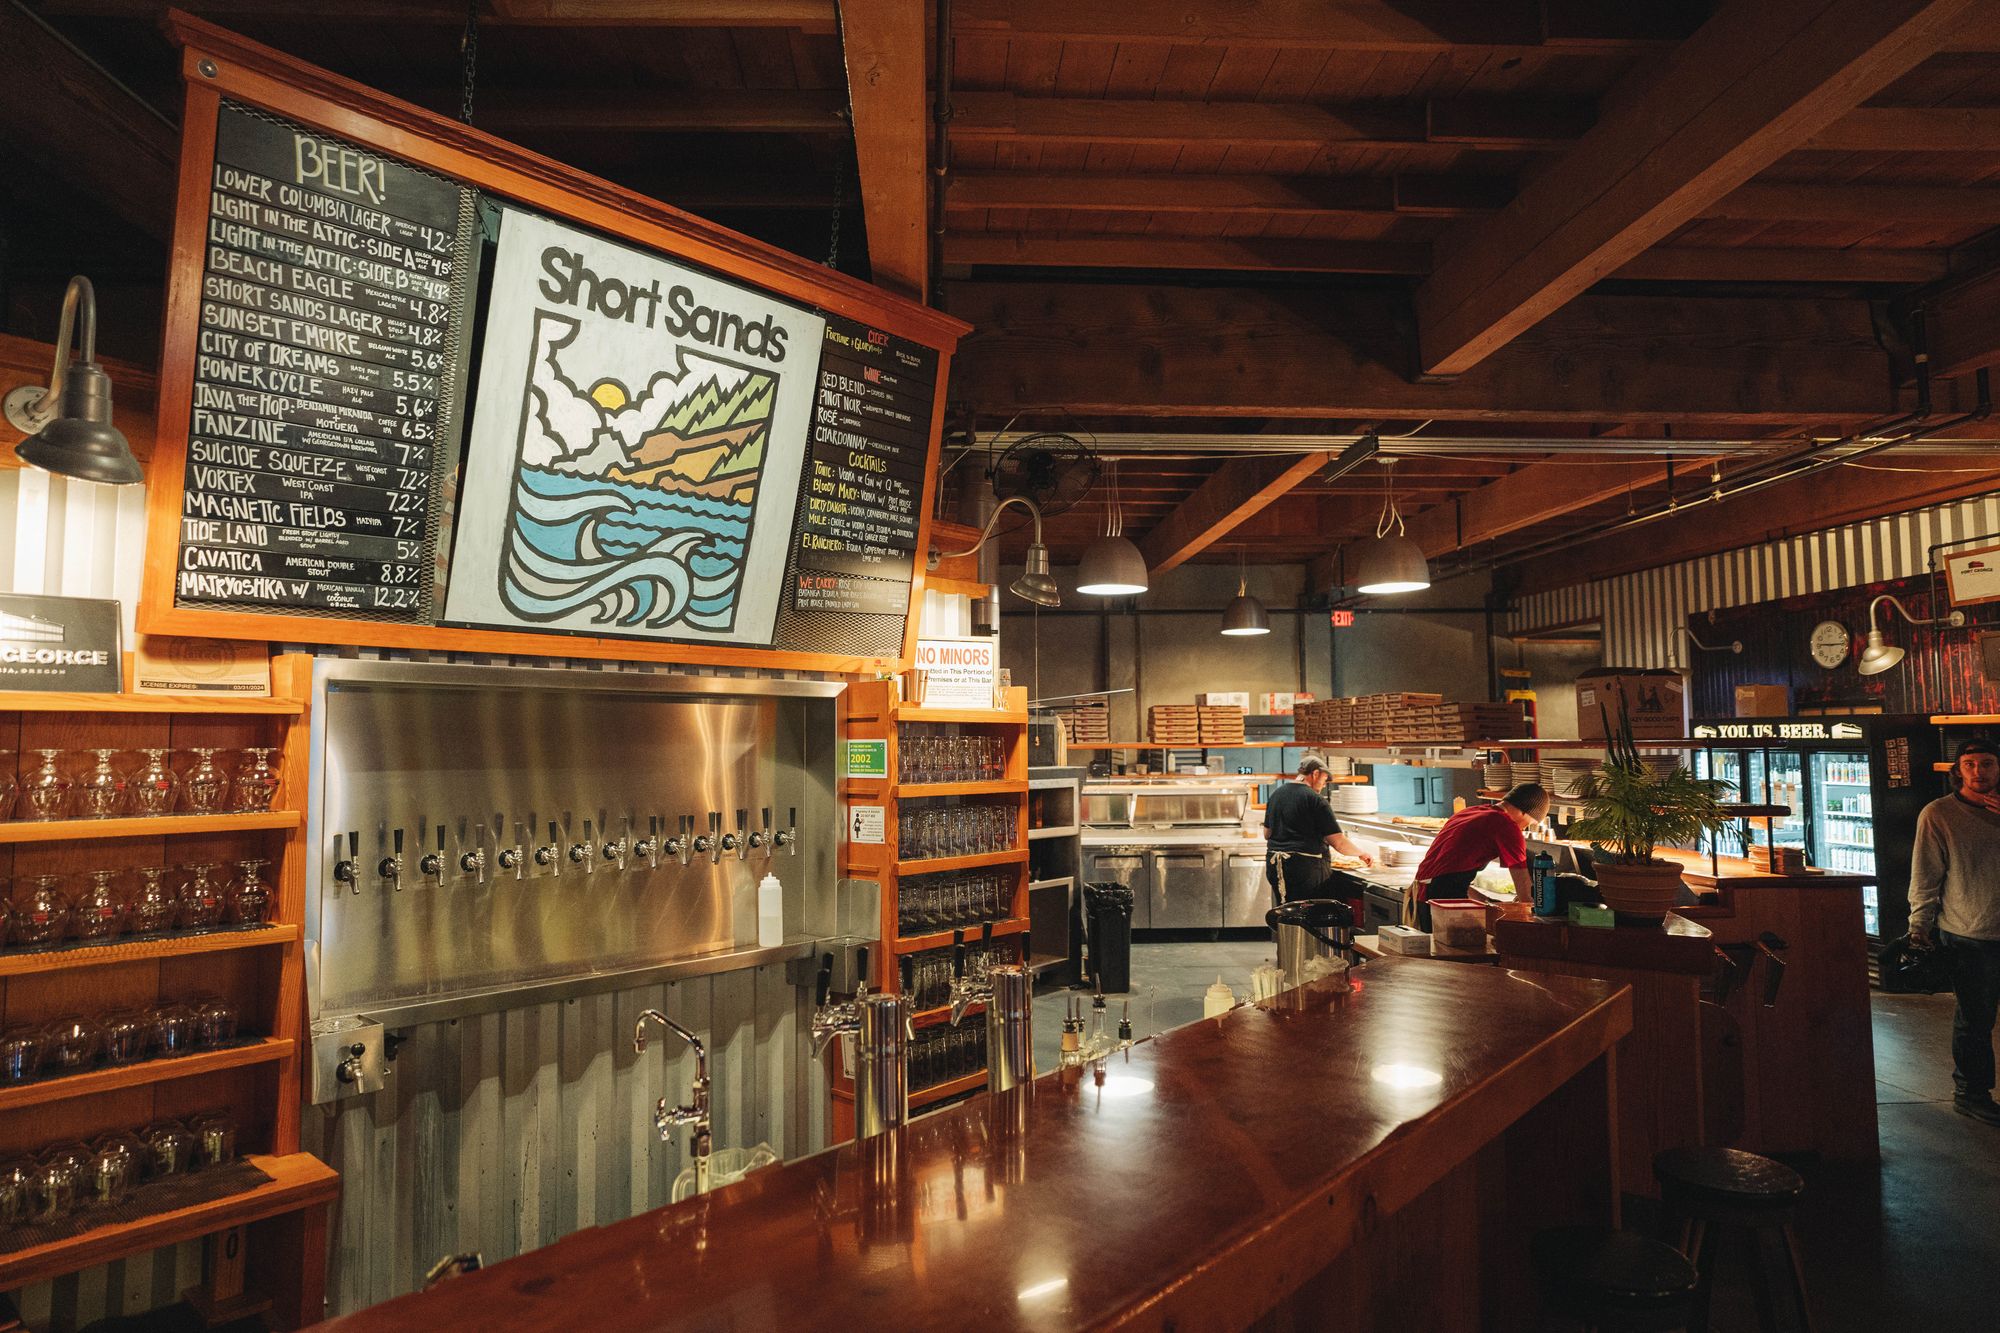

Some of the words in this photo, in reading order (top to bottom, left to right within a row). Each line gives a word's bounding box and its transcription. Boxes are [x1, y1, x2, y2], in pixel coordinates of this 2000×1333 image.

[294, 134, 385, 205] BEER!
[216, 164, 272, 202] LOWER
[280, 185, 348, 222] COLUMBIA
[350, 205, 391, 236] LAGER
[212, 192, 260, 225] LIGHT
[264, 209, 279, 226] IN
[281, 213, 308, 234] THE
[404, 248, 417, 271] A
[420, 226, 455, 252] 4.2%
[211, 218, 260, 250] LIGHT
[263, 236, 276, 250] IN
[278, 240, 303, 256] THE
[396, 268, 409, 290] B
[211, 246, 283, 285] BEACH
[292, 268, 354, 300] EAGLE
[431, 259, 453, 276] 4.5%
[365, 288, 390, 300] MEXICAN
[391, 294, 407, 304] STYLE
[423, 281, 450, 299] 4.9%
[206, 277, 266, 306] SHORT
[270, 292, 327, 321] SANDS
[330, 305, 384, 336] LAGER
[377, 300, 397, 310] LAGER
[410, 300, 449, 324] 4.8%
[539, 246, 662, 329] Short
[664, 285, 788, 363] Sands
[205, 303, 286, 340] SUNSET
[291, 321, 362, 355] EMPIRE
[408, 325, 443, 346] 4.8%
[825, 326, 850, 346] FORTUNE
[201, 330, 238, 359] CITY
[244, 341, 266, 361] OF
[269, 342, 339, 376] DREAMS
[411, 350, 443, 369] 5.6%
[199, 354, 268, 390] POWER
[269, 370, 324, 396] CYCLE
[350, 364, 366, 373] HAZY
[342, 385, 358, 395] HAZY
[360, 389, 375, 398] PALE
[393, 371, 433, 392] 5.5%
[821, 370, 838, 388] RED
[840, 375, 866, 396] BLEND
[193, 381, 237, 412] JAVA
[236, 393, 258, 407] THE
[351, 396, 363, 404] ALE
[395, 395, 433, 418] 5.6%
[818, 388, 841, 408] PINOT
[843, 396, 863, 415] NOIR
[297, 398, 337, 414] BENJAMIN
[339, 406, 373, 421] MIRANDA
[817, 406, 838, 426] ROSÉ
[194, 409, 288, 444] FANZINE
[316, 418, 359, 434] MOTUEKA
[378, 418, 398, 428] COFFEE
[383, 426, 392, 435] IPA
[401, 421, 434, 440] 6.5%
[307, 430, 341, 441] AMERICAN
[343, 436, 354, 444] IPA
[354, 438, 375, 447] COLLAB
[312, 438, 350, 450] GEORGETOWN
[351, 444, 378, 454] BREWING
[815, 426, 868, 450] CHARDONNAY
[191, 440, 262, 469] SUICIDE
[268, 450, 347, 480] SQUEEZE
[394, 442, 426, 465] 7%
[848, 450, 887, 473] COCKTAILS
[193, 464, 256, 494] VORTEX
[355, 464, 371, 473] WEST
[371, 466, 387, 475] COAST
[365, 474, 376, 482] IPA
[396, 468, 430, 490] 7.2%
[814, 460, 835, 477] TONIC:
[838, 466, 856, 482] VODKA
[885, 479, 892, 491] Q
[282, 476, 307, 489] WEST
[308, 480, 334, 493] COAST
[812, 477, 836, 496] BLOODY
[838, 482, 860, 500] MARY:
[860, 489, 876, 502] VODKA
[300, 490, 314, 500] IPA
[386, 491, 425, 512] 7.2%
[809, 497, 827, 512] DIRTY
[185, 491, 284, 524] MAGNETIC
[289, 503, 347, 528] FIELDS
[356, 516, 372, 525] HAZY
[392, 516, 419, 537] 7%
[830, 517, 846, 527] CHOICE
[183, 519, 222, 542] TIDE
[226, 522, 268, 547] LAND
[282, 528, 300, 536] FRESH
[319, 531, 340, 540] LIGHTLY
[802, 532, 811, 548] EL
[184, 546, 263, 572] CAVATICA
[397, 541, 419, 560] 5%
[285, 556, 325, 568] AMERICAN
[327, 560, 355, 571] DOUBLE
[307, 568, 331, 577] STOUT
[381, 564, 420, 584] 8.8%
[800, 576, 813, 589] WE
[180, 572, 287, 600] MATRYOSHKA
[316, 583, 343, 592] MEXICAN
[344, 586, 365, 594] VANILLA
[326, 595, 354, 603] COCONUT
[373, 586, 420, 608] 12.2%
[1334, 610, 1351, 626] EXIT
[2, 647, 108, 666] GEORGE
[917, 647, 936, 664] NO
[940, 647, 989, 666] MINORS
[140, 681, 168, 689] LICENSE
[1718, 724, 1751, 739] YOU.
[1753, 724, 1777, 738] US.
[1779, 723, 1830, 739] BEER.
[850, 754, 871, 763] 2002
